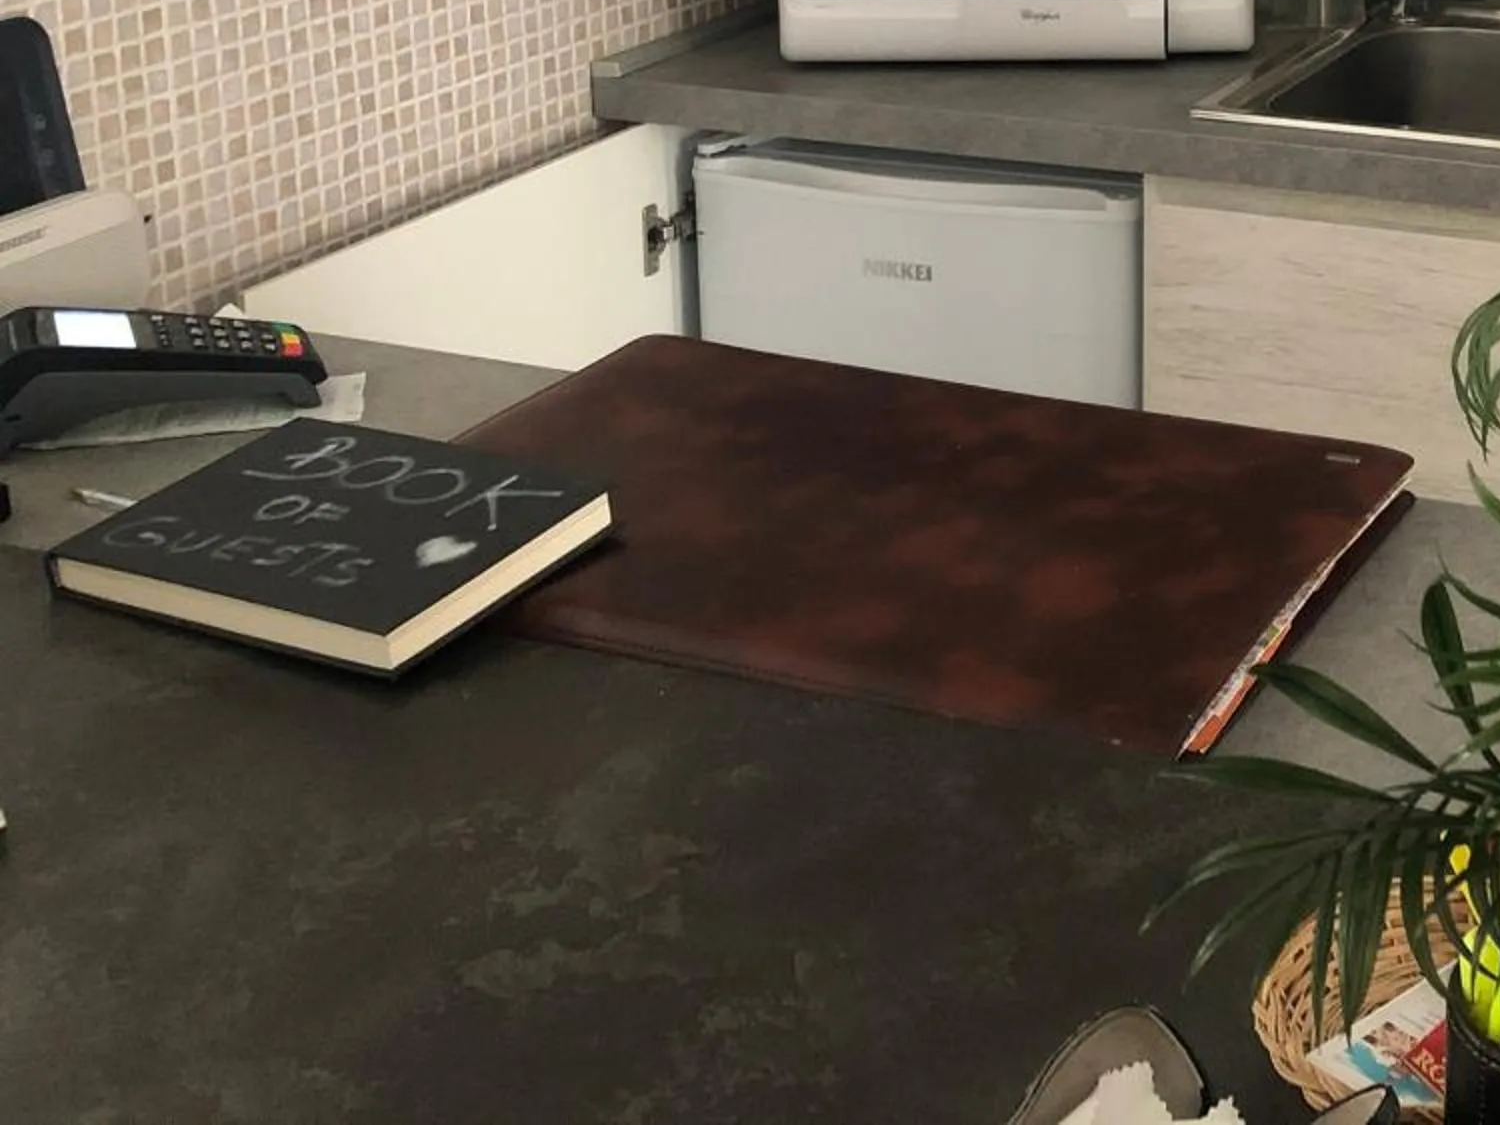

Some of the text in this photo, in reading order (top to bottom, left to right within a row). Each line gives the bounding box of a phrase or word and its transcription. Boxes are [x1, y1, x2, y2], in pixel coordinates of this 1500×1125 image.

[243, 436, 565, 531] BOOK
[253, 494, 351, 524] OF
[103, 515, 376, 588] GUESTS
